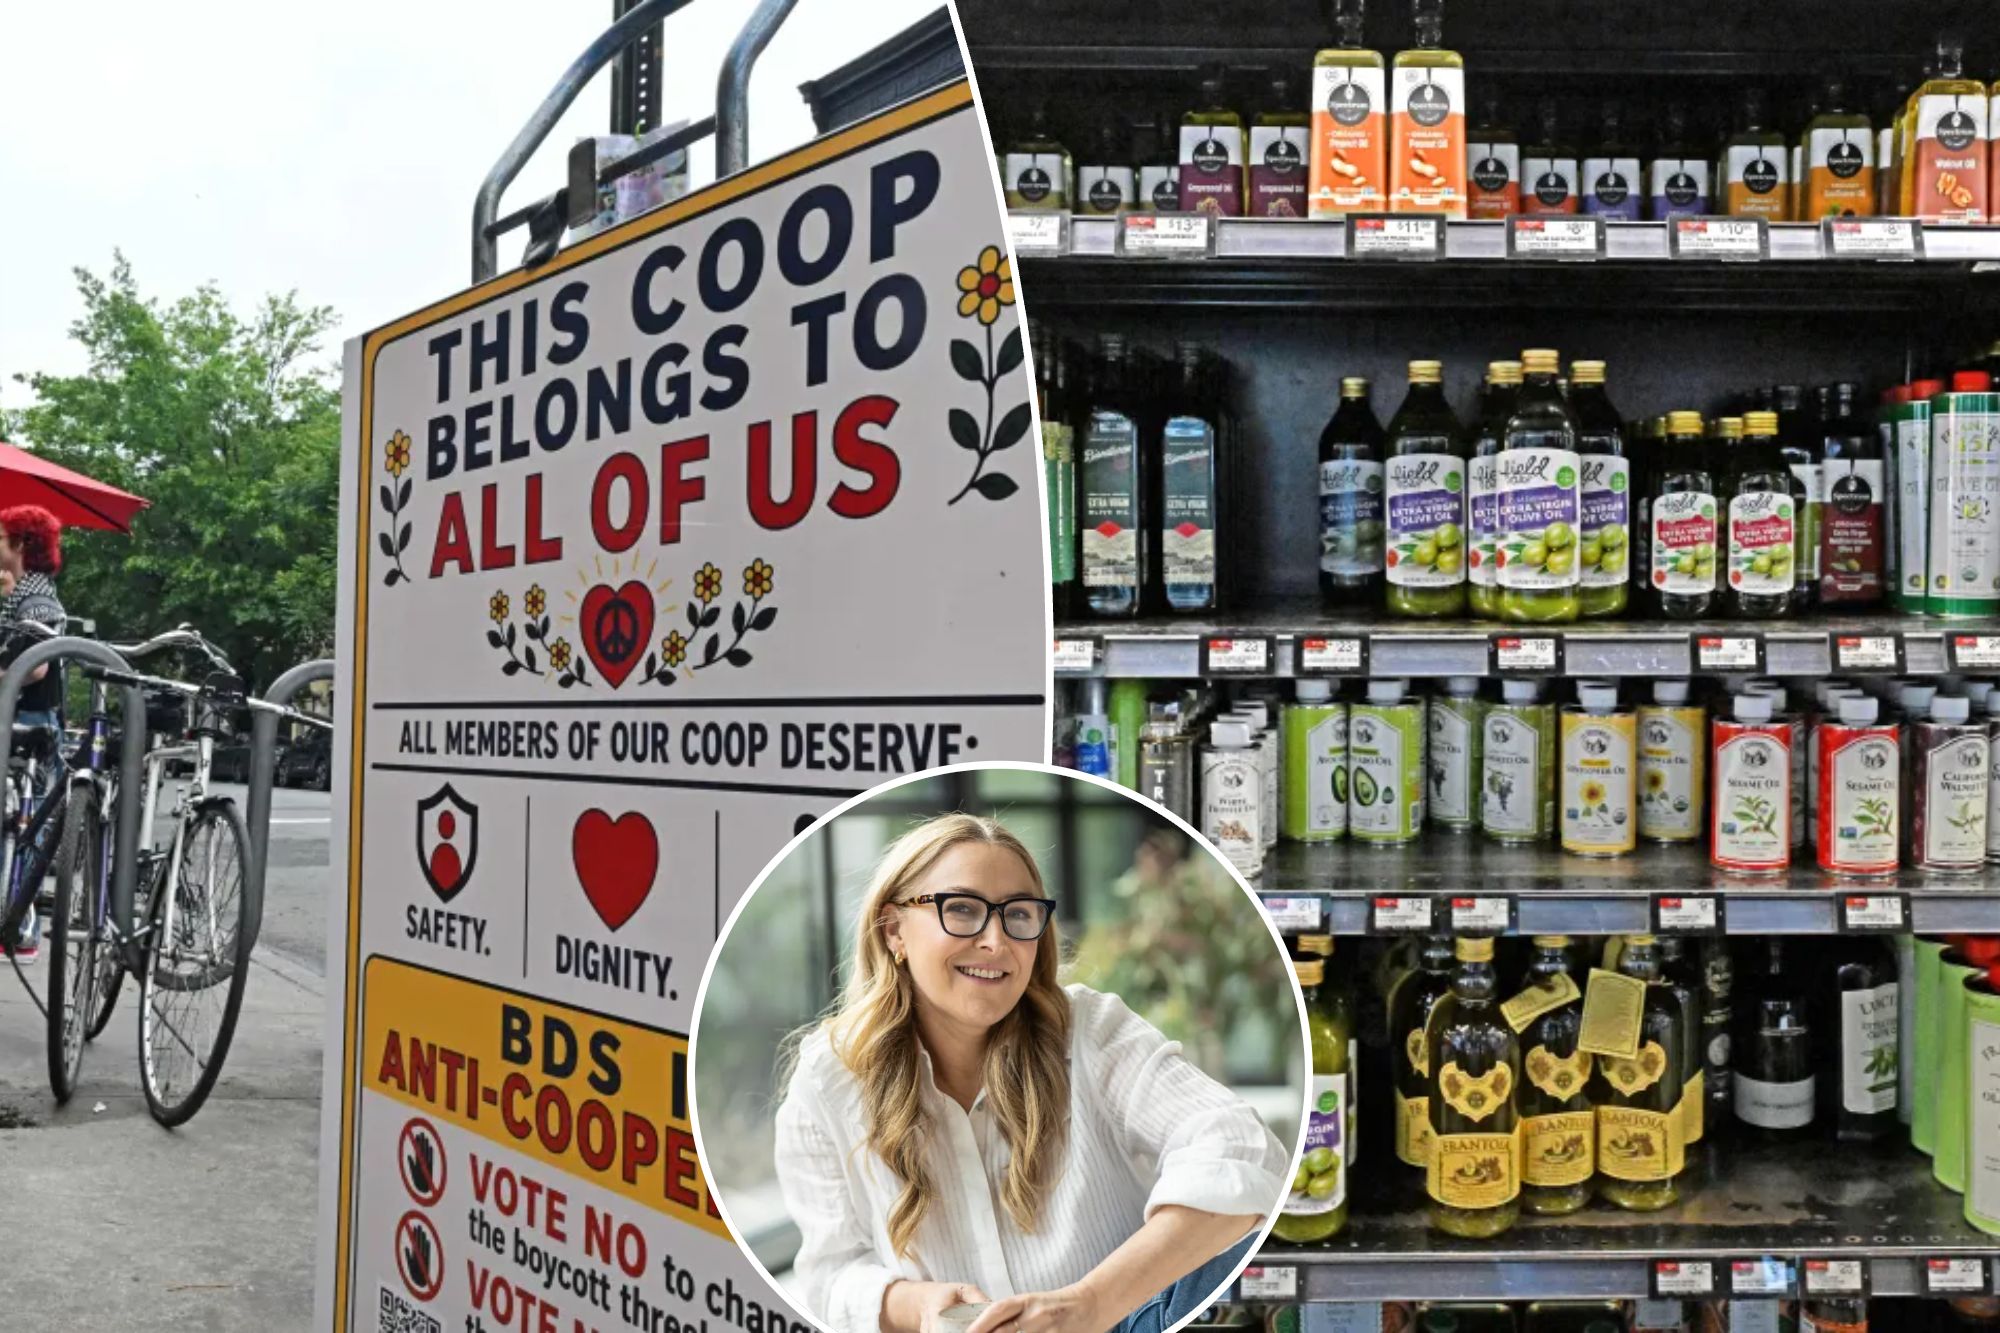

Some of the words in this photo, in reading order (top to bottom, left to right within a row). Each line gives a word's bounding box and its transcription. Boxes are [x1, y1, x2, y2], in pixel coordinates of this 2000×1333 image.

[428, 281, 590, 404] THIS
[630, 149, 942, 336] COOP
[426, 324, 750, 482] BELONGS
[792, 274, 928, 388] TO
[429, 473, 563, 578] ALL
[591, 434, 710, 554] OF
[747, 394, 901, 531] US
[1500, 503, 1534, 516] EXTRA
[1535, 499, 1572, 512] VIRGIN
[1508, 512, 1541, 525] OLIVE
[1544, 509, 1564, 521] OIL
[399, 720, 437, 755] ALL
[444, 720, 559, 760] MEMBERS
[568, 721, 602, 762] OF
[610, 721, 669, 765] OUR
[681, 721, 768, 769] COOP
[405, 905, 491, 956] SAFETY.
[555, 934, 678, 1001] DIGNITY.
[502, 1003, 621, 1097] BDS
[378, 1029, 723, 1220] ANTI-COOPE
[1308, 1122, 1335, 1134] RGIN
[468, 1208, 505, 1254] the
[513, 1227, 611, 1313] boycott
[469, 1153, 567, 1244] VOTE
[584, 1204, 648, 1278] NO
[663, 1254, 695, 1302] to
[467, 1259, 559, 1333] VOTE
